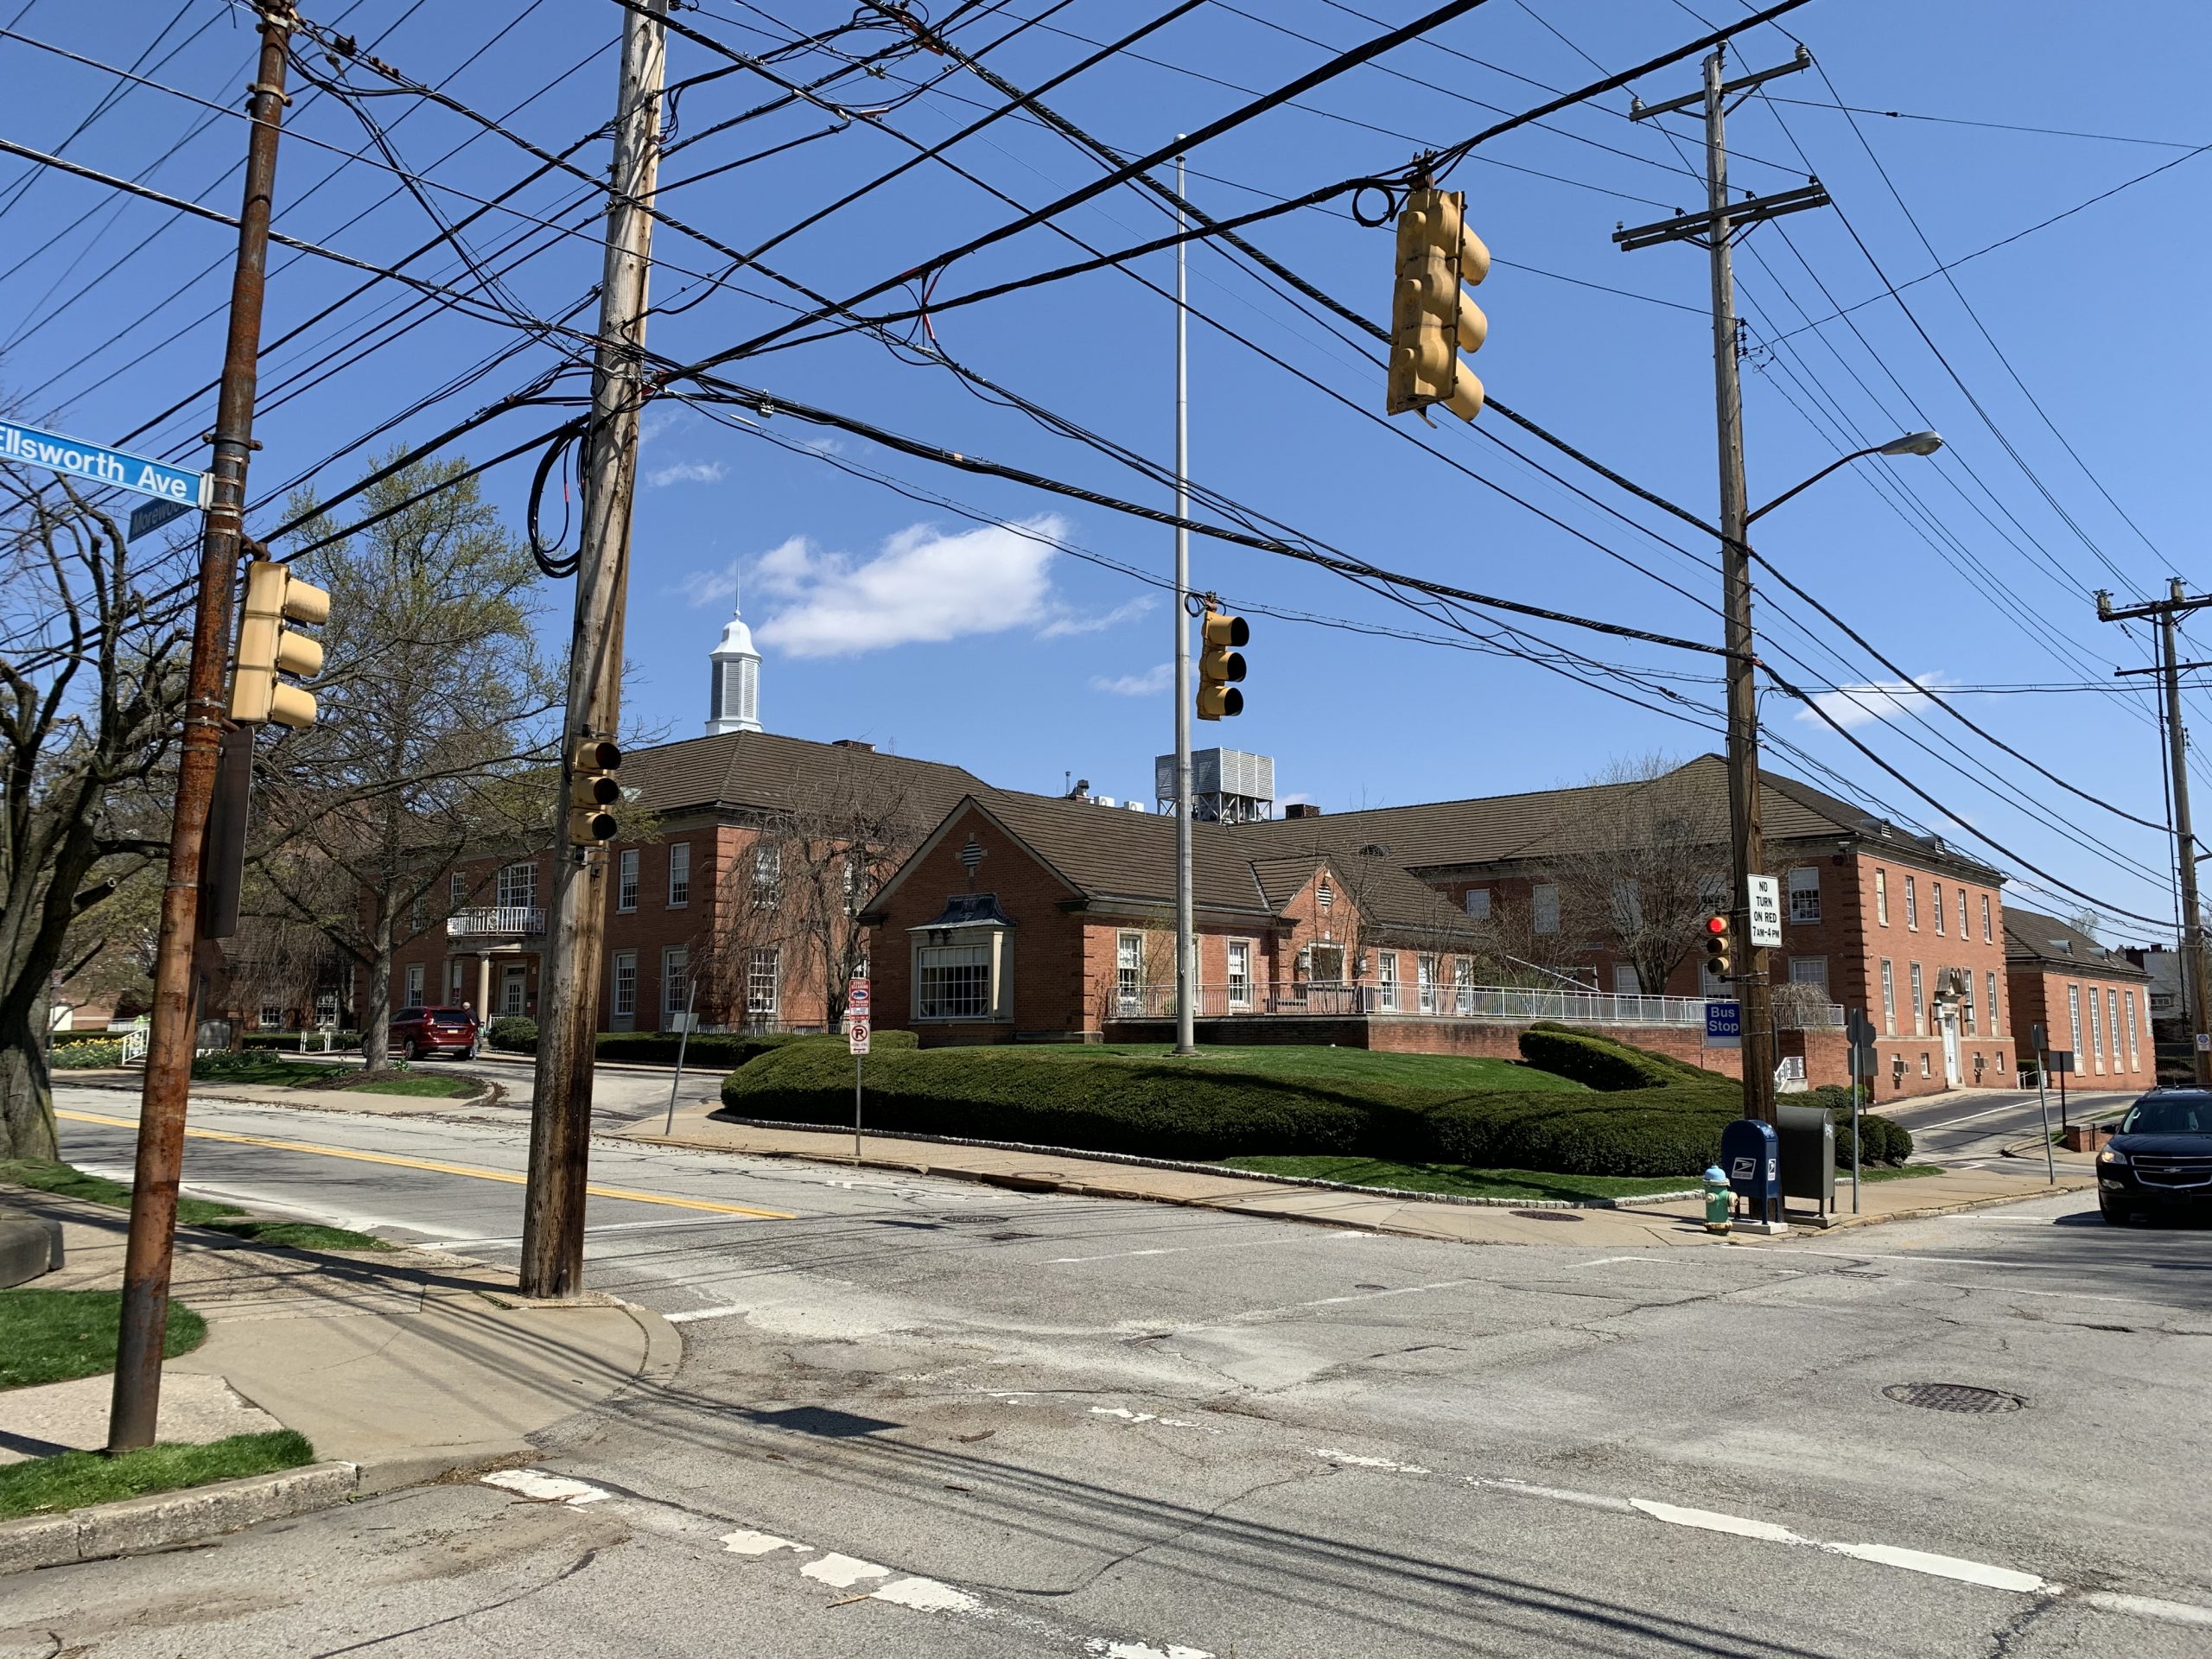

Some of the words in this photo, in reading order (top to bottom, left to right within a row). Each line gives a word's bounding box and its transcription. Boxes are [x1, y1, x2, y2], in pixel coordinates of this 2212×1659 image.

[137, 465, 188, 498] Ave
[1758, 880, 1768, 892] NO
[1756, 896, 1772, 907] TURN
[1753, 911, 1763, 922] ON
[1764, 912, 1777, 923] RED
[1711, 1007, 1735, 1018] Bus
[1708, 1020, 1739, 1033] Stop
